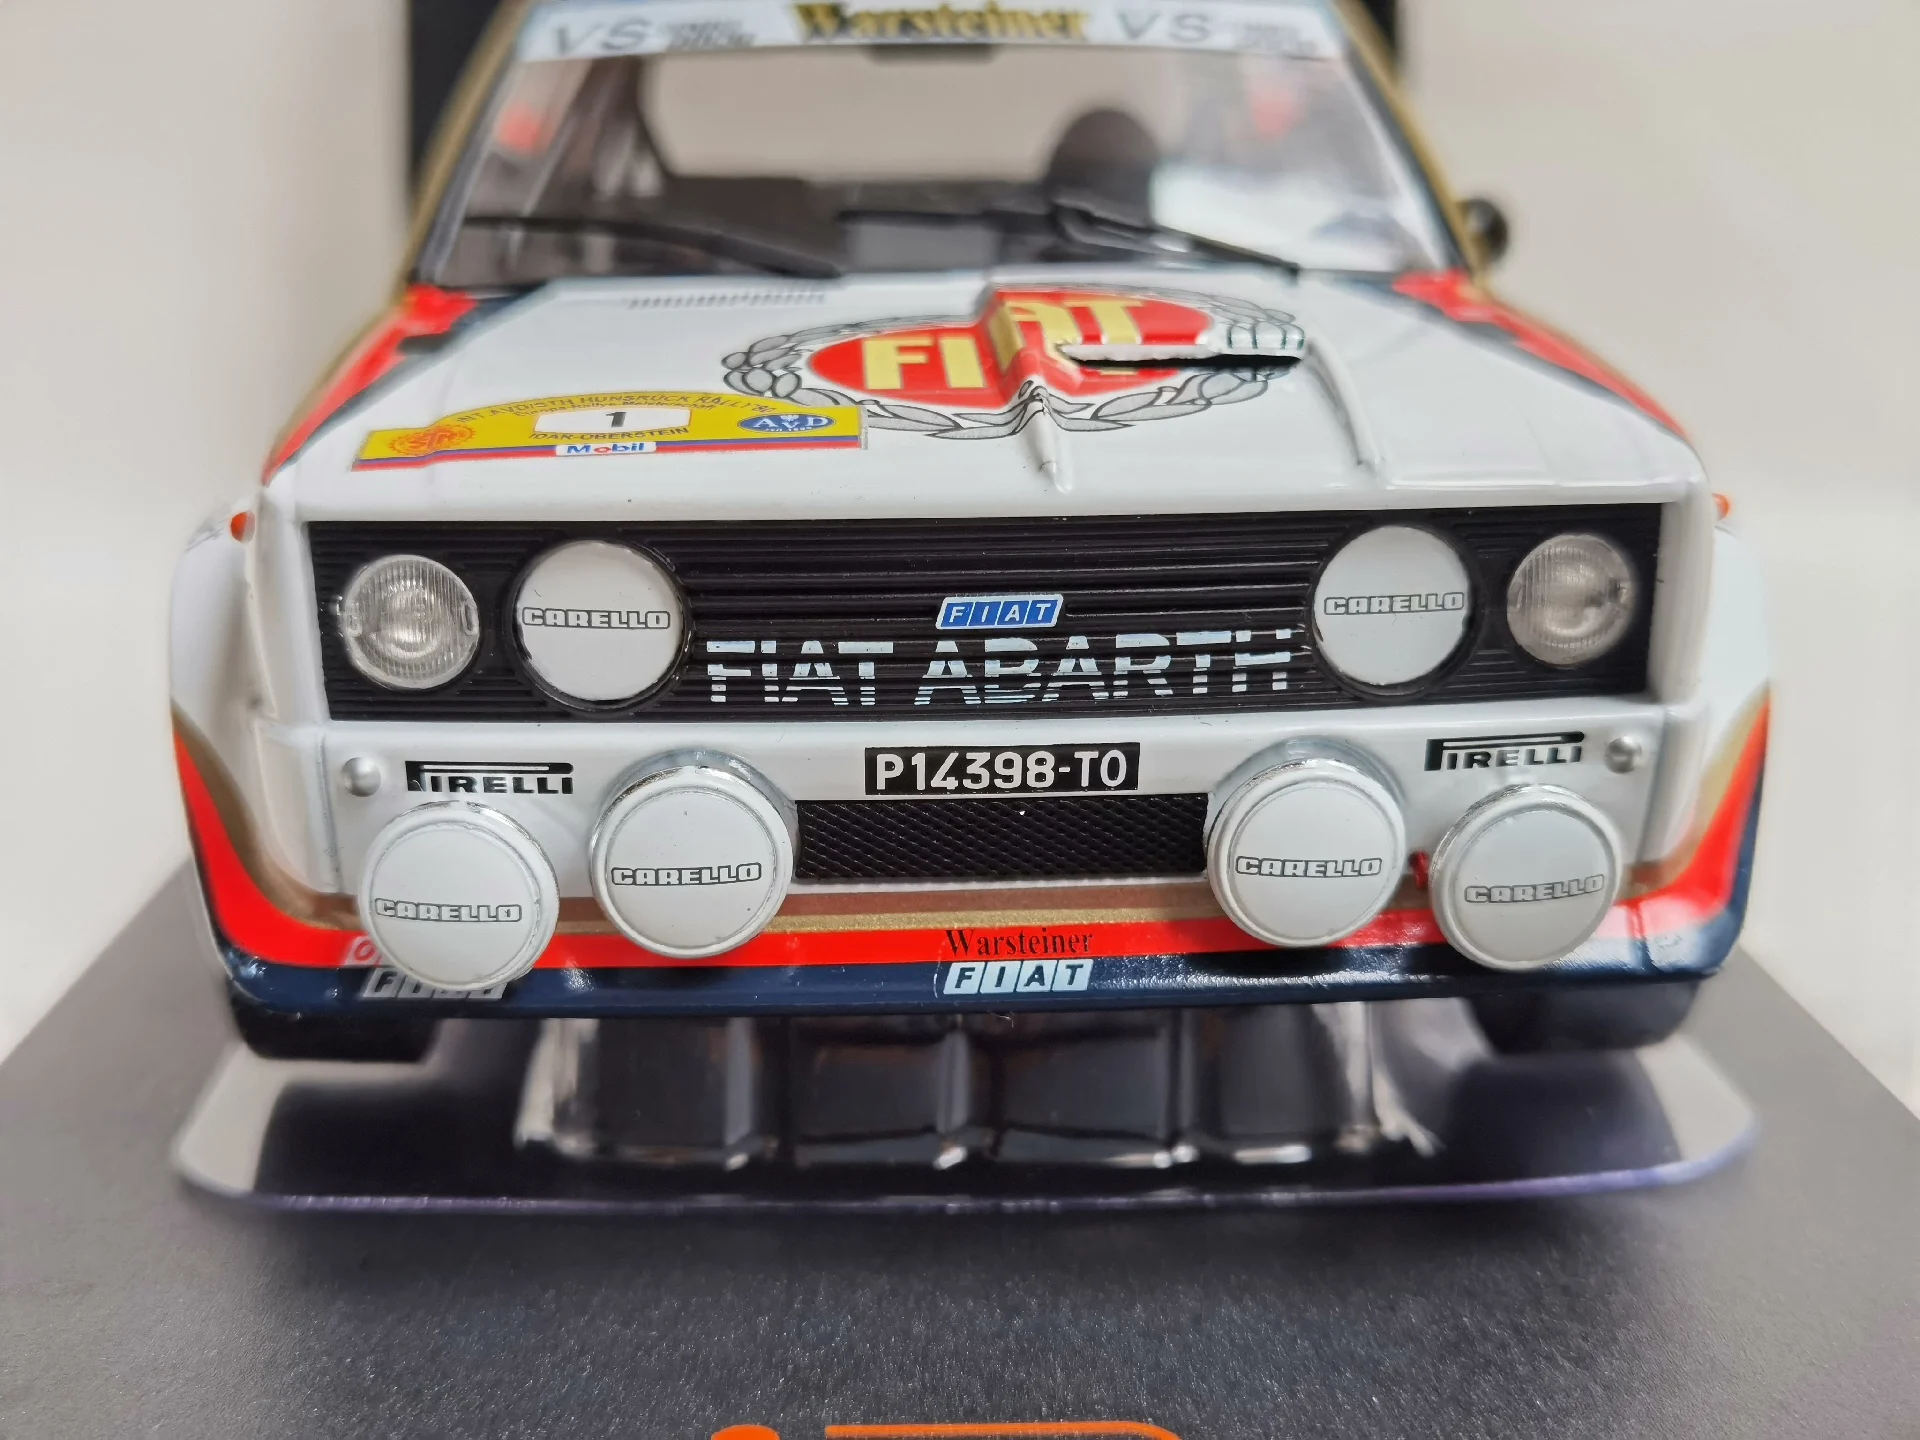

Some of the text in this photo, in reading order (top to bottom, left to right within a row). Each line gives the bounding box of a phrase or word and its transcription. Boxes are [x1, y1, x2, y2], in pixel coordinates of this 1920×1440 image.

[553, 18, 655, 54] VS
[1120, 12, 1212, 42] VS
[862, 299, 1144, 390] FIAT
[607, 410, 631, 428] 1
[565, 442, 647, 456] Mobil
[948, 601, 1054, 625] FIAT
[1323, 592, 1465, 616] CARELLO
[521, 607, 671, 630] CARELLO
[706, 628, 1292, 706] FIAT ABARTH
[1424, 731, 1585, 772] PIRELLI
[405, 760, 575, 795] PIRELLI
[610, 862, 762, 886] CARELLO
[1235, 856, 1383, 878] CARELLO
[1464, 874, 1606, 904] CARELLO
[374, 898, 523, 922] CARELLO
[945, 928, 1093, 956] Warsteiner
[955, 963, 1084, 988] FIAT
